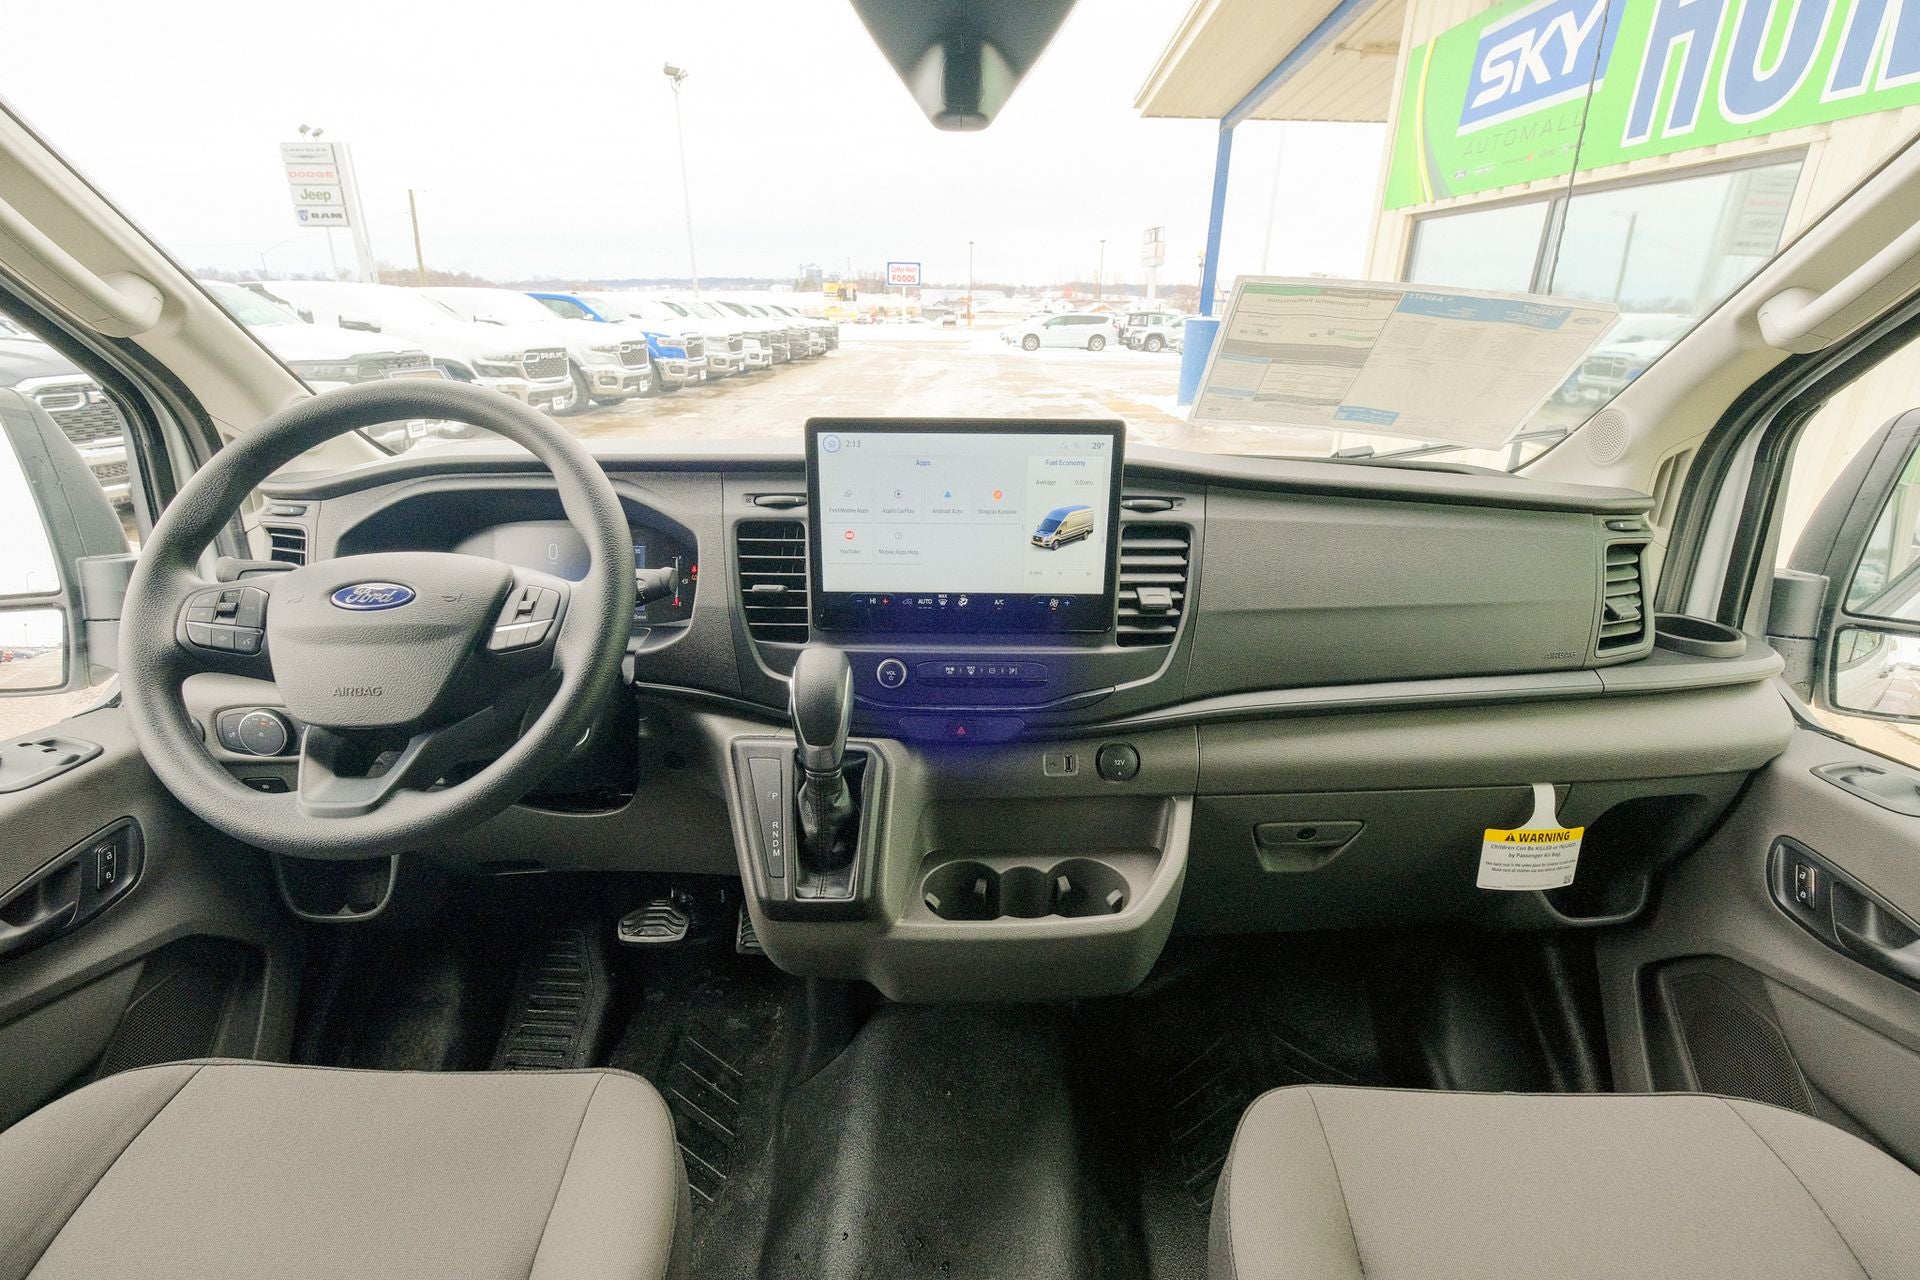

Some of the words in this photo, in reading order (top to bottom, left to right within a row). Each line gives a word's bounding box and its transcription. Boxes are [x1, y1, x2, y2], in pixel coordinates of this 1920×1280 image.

[1471, 0, 1606, 109] SKY
[1462, 110, 1584, 158] AUTOMALL
[288, 170, 335, 178] DODGE
[300, 188, 332, 203] Jeep
[892, 274, 916, 282] FOODS
[845, 440, 861, 448] 2:13
[915, 459, 931, 467] Apps
[1060, 459, 1086, 467] Economy
[345, 587, 398, 604] Ford
[333, 686, 382, 697] AIRBAG
[1519, 831, 1570, 843] WARNING
[1490, 843, 1515, 851] Children
[772, 849, 780, 857] M
